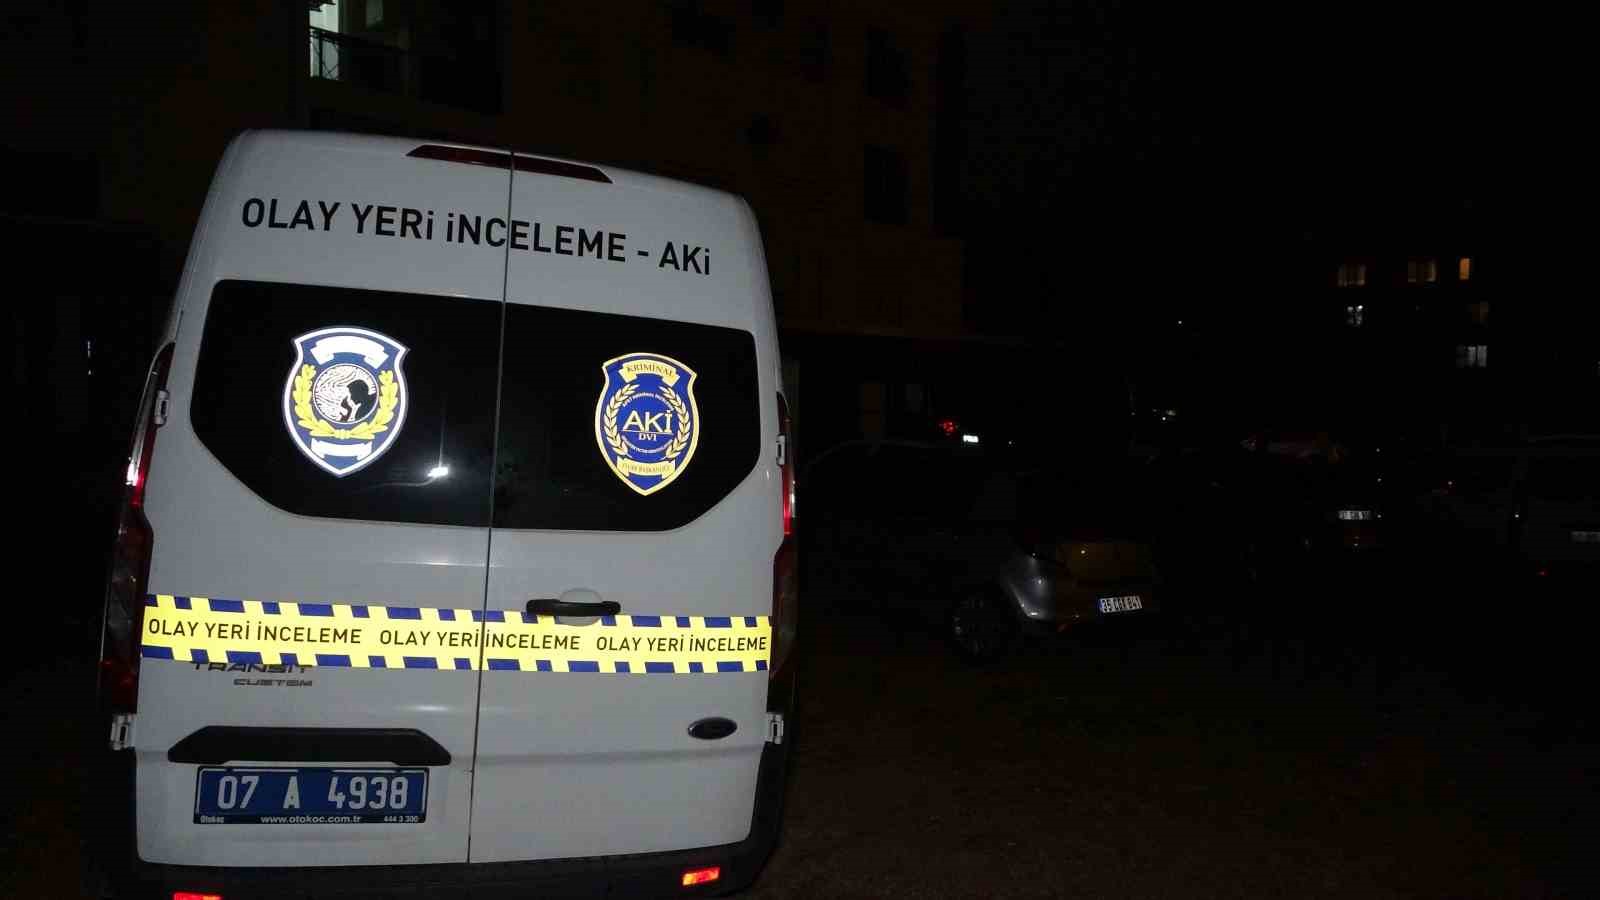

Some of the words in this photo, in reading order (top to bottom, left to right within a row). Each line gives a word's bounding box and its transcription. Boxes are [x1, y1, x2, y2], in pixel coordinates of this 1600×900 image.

[242, 198, 340, 231] OLAY
[622, 409, 673, 433] AKİ
[639, 432, 657, 442] DVI
[149, 618, 199, 638] OLAY
[205, 620, 250, 640] YERİ
[257, 621, 362, 644] İNCELEME
[380, 629, 431, 646] OLAY
[437, 628, 480, 648] YERİ
[485, 629, 582, 650] İNCELEME
[596, 635, 642, 651] OLAY
[647, 634, 684, 652] YERİ
[689, 634, 767, 652] İNCELEME
[217, 775, 260, 809] 07
[282, 776, 300, 809] A
[327, 776, 409, 809] 4938
[260, 814, 361, 824] www.otokoc.com.tr
